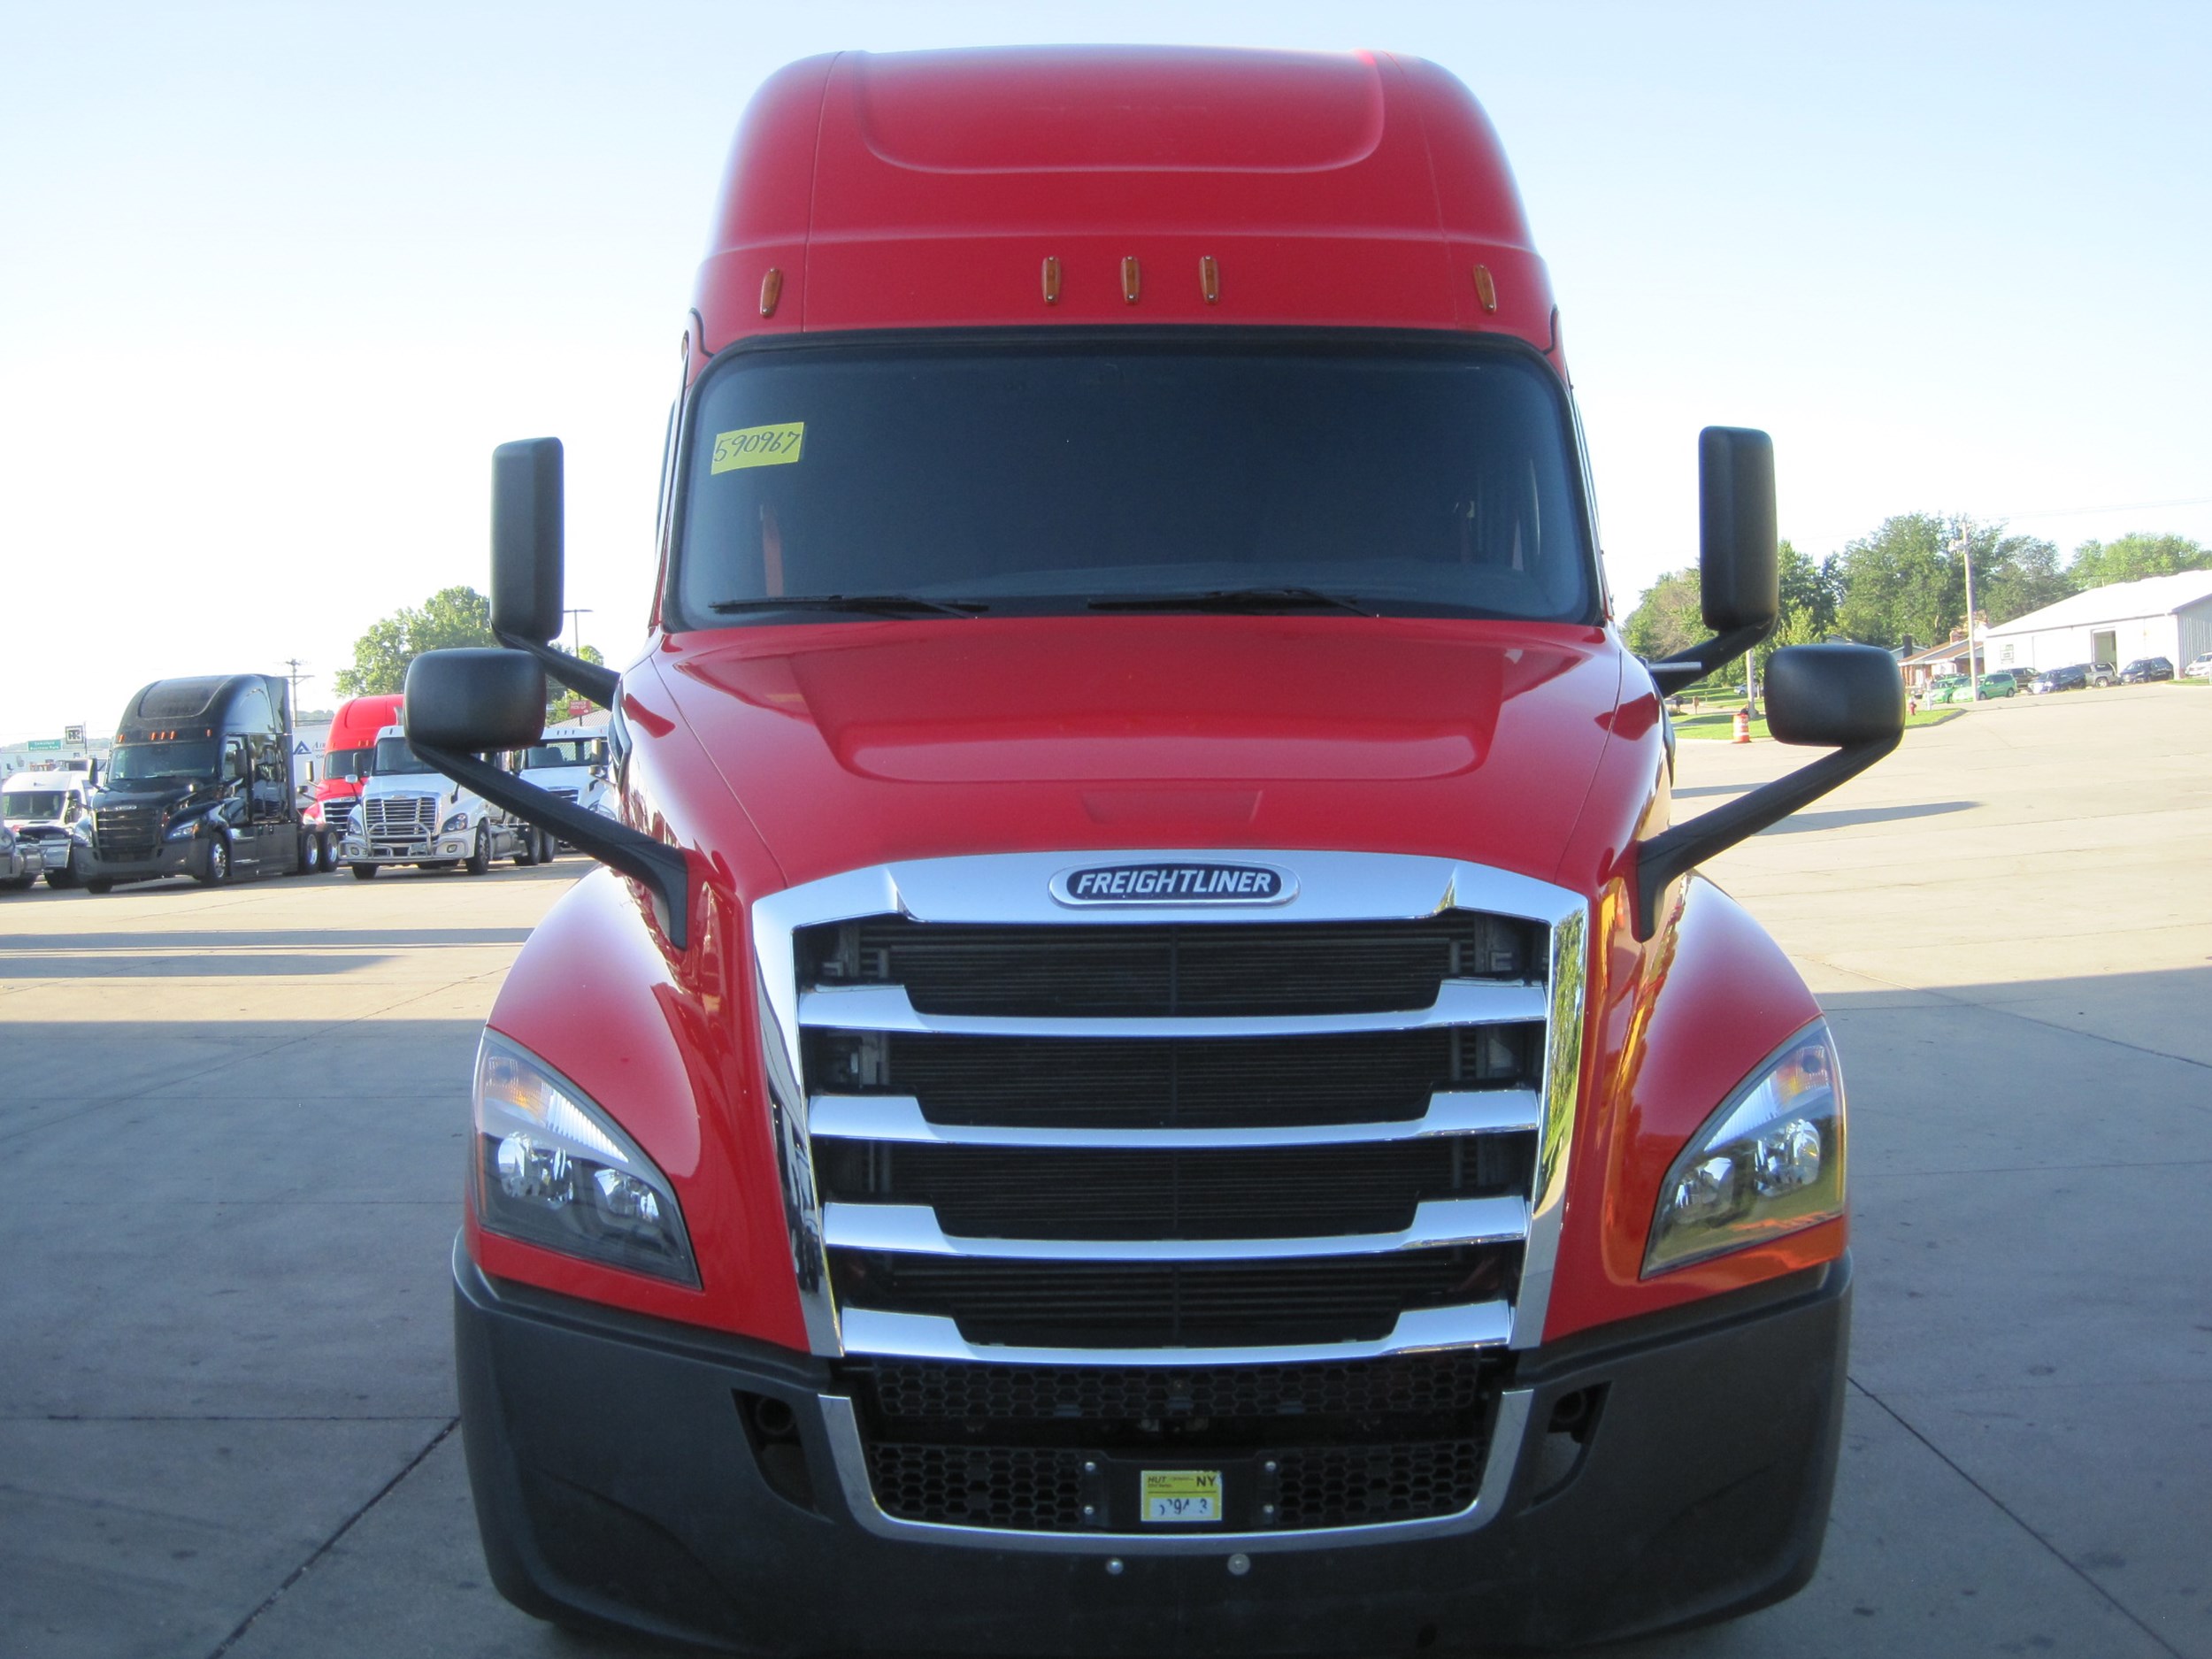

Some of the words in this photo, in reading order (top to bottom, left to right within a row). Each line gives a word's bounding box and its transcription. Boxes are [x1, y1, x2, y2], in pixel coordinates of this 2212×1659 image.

[713, 431, 801, 462] 590967
[1076, 869, 1271, 894] FREIGHTLINER
[1196, 1476, 1217, 1487] NY
